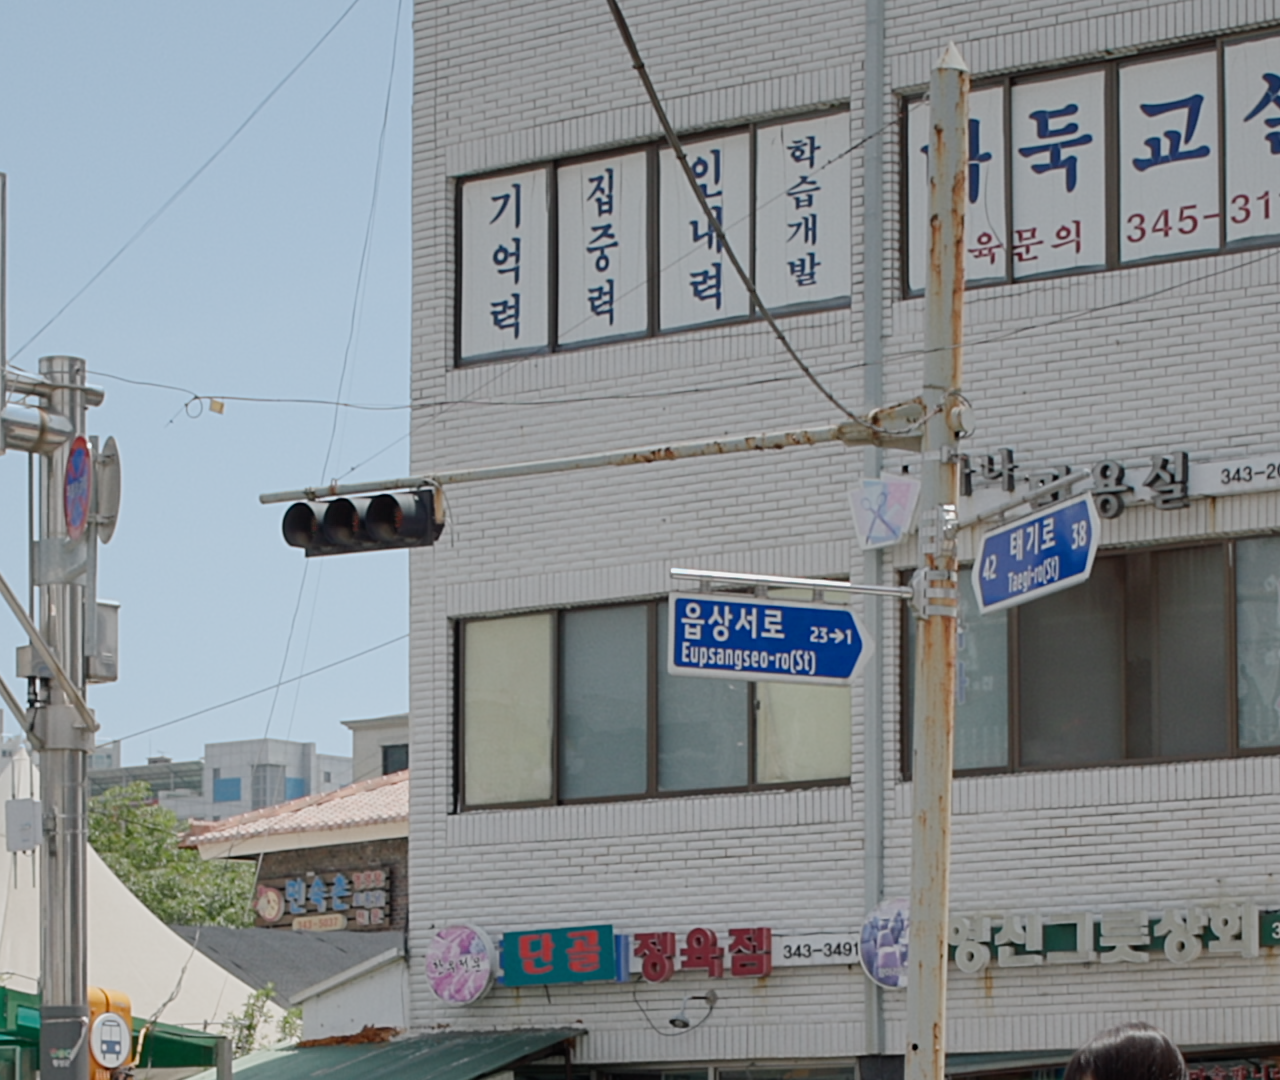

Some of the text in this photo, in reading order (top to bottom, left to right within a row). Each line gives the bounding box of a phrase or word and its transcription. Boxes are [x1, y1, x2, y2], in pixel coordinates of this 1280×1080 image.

[689, 149, 723, 311] 인내력
[787, 137, 822, 287] 학습개발
[490, 184, 522, 340] 기억력
[586, 168, 619, 325] 집중력
[968, 220, 1082, 265] 육문의
[1010, 519, 1088, 560] 태기로 38
[982, 558, 997, 581] 42
[1007, 555, 1060, 593] Taegi-ro(St)
[681, 601, 786, 642] 읍상서로
[810, 626, 829, 643] 23
[681, 642, 817, 673] Eupsangseo-ro(St)
[519, 927, 859, 983] 단골 정육점 343-3491
